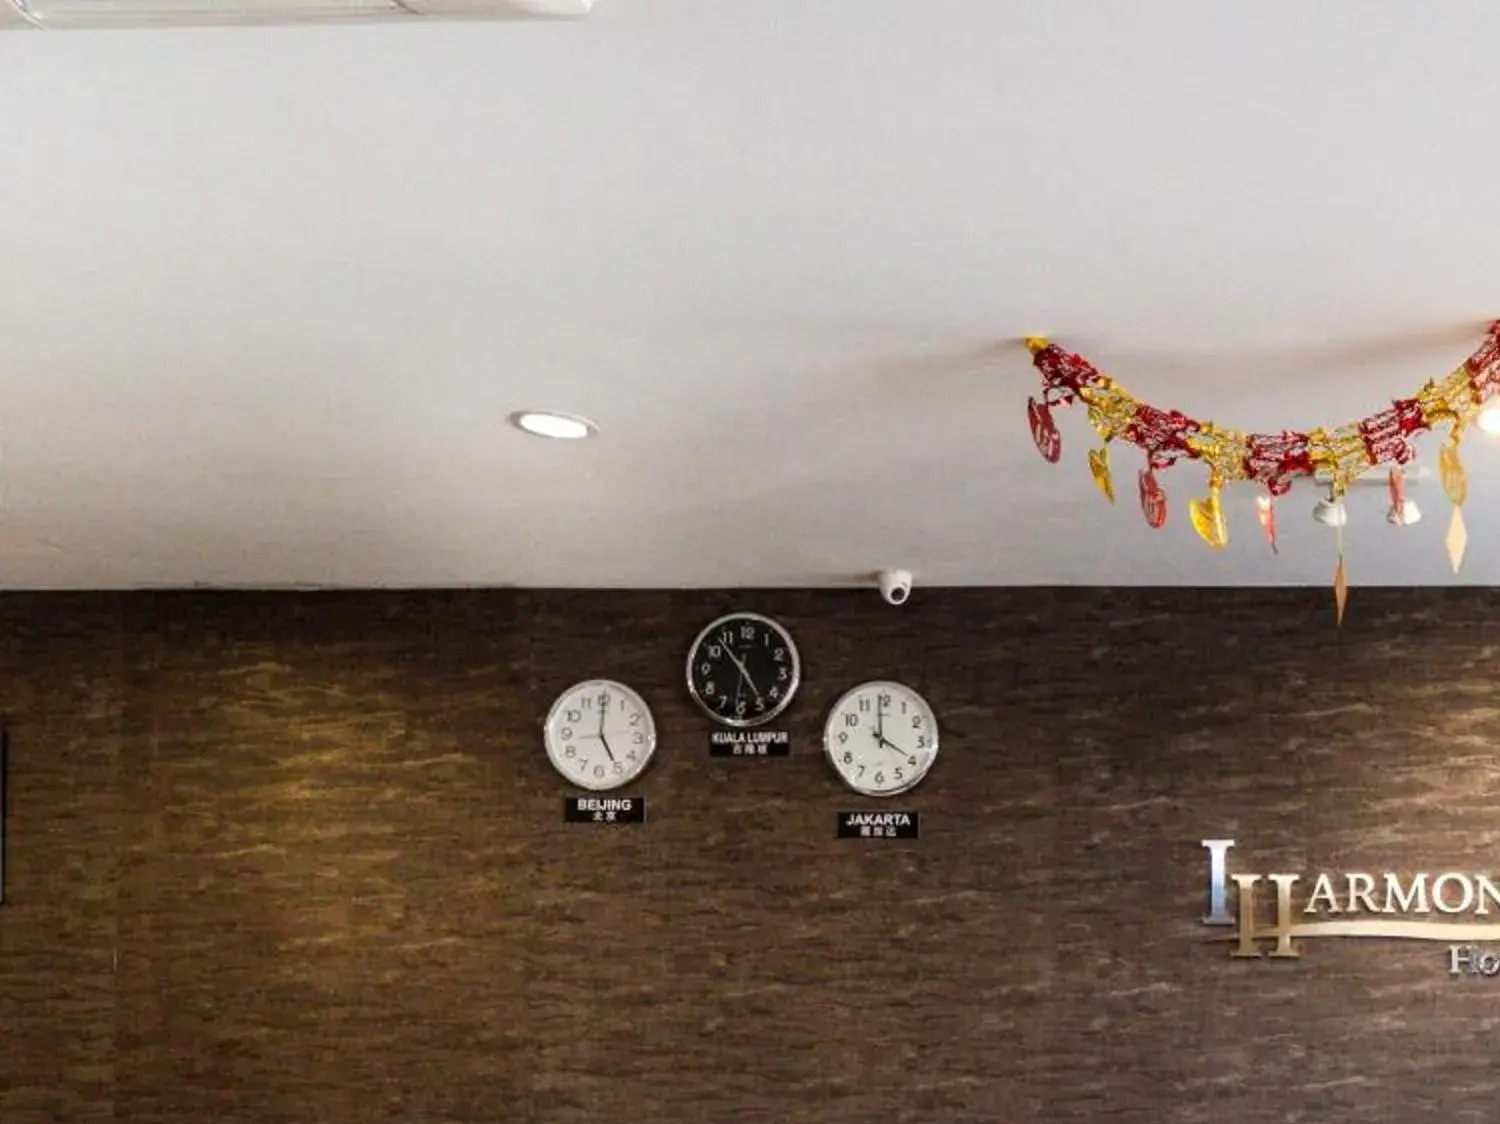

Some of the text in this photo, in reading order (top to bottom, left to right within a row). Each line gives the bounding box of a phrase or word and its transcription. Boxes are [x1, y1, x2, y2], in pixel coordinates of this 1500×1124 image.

[712, 731, 788, 744] KUALA LUMPUR
[577, 798, 632, 811] BEIJING
[846, 813, 911, 826] JAKARTA
